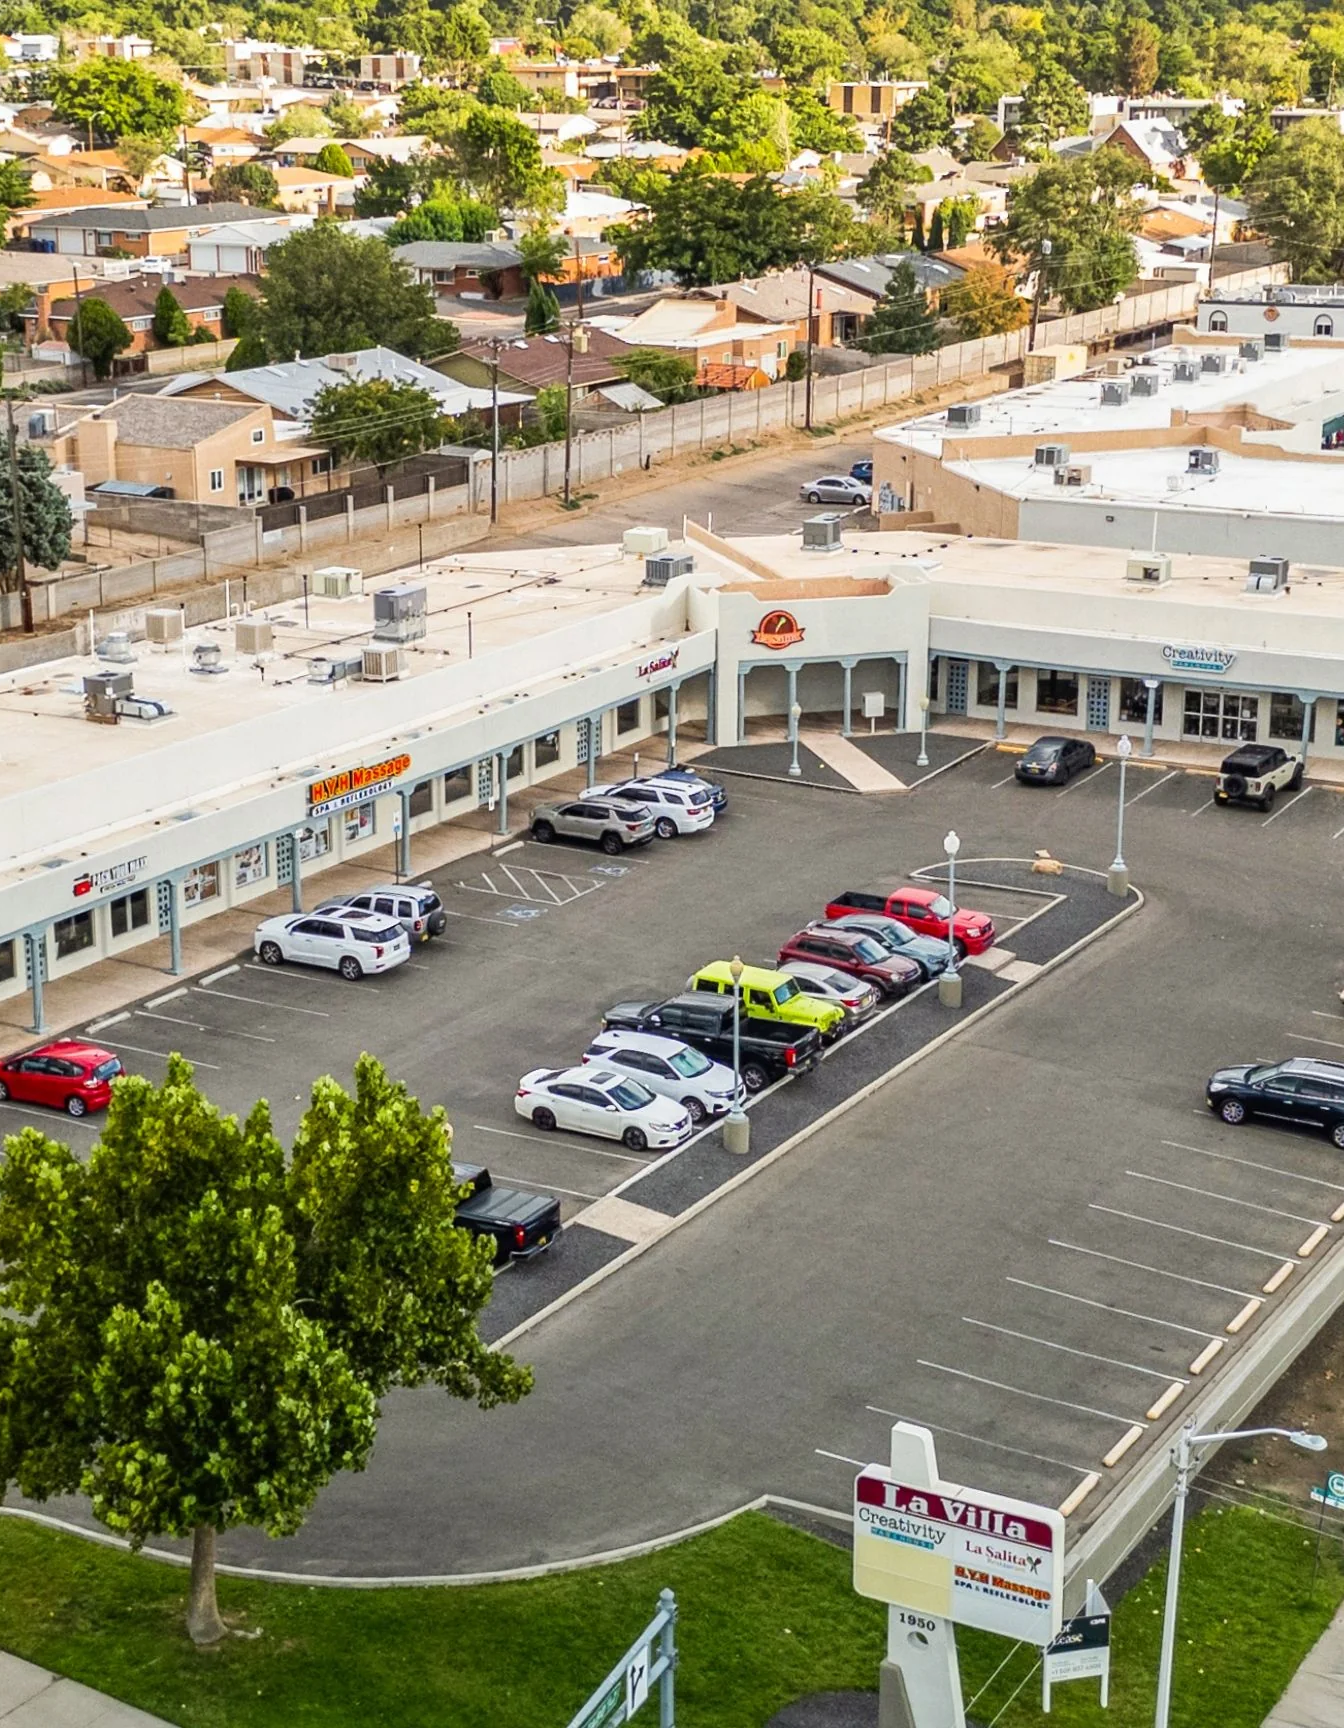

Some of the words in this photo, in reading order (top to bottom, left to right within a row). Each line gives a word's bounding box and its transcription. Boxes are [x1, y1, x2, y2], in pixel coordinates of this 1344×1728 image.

[1162, 645, 1235, 667] Creativity
[352, 753, 411, 790] Massage
[315, 804, 330, 815] SPA
[859, 1507, 946, 1544] Creativity
[882, 1483, 930, 1516] La
[940, 1498, 1028, 1542] Villa
[965, 1540, 982, 1557] La
[986, 1545, 1027, 1567] Salita
[954, 1579, 973, 1591] SPA
[982, 1587, 1051, 1610] REFLEXOLOGY
[992, 1575, 1052, 1602] Massage
[899, 1612, 937, 1632] 1950
